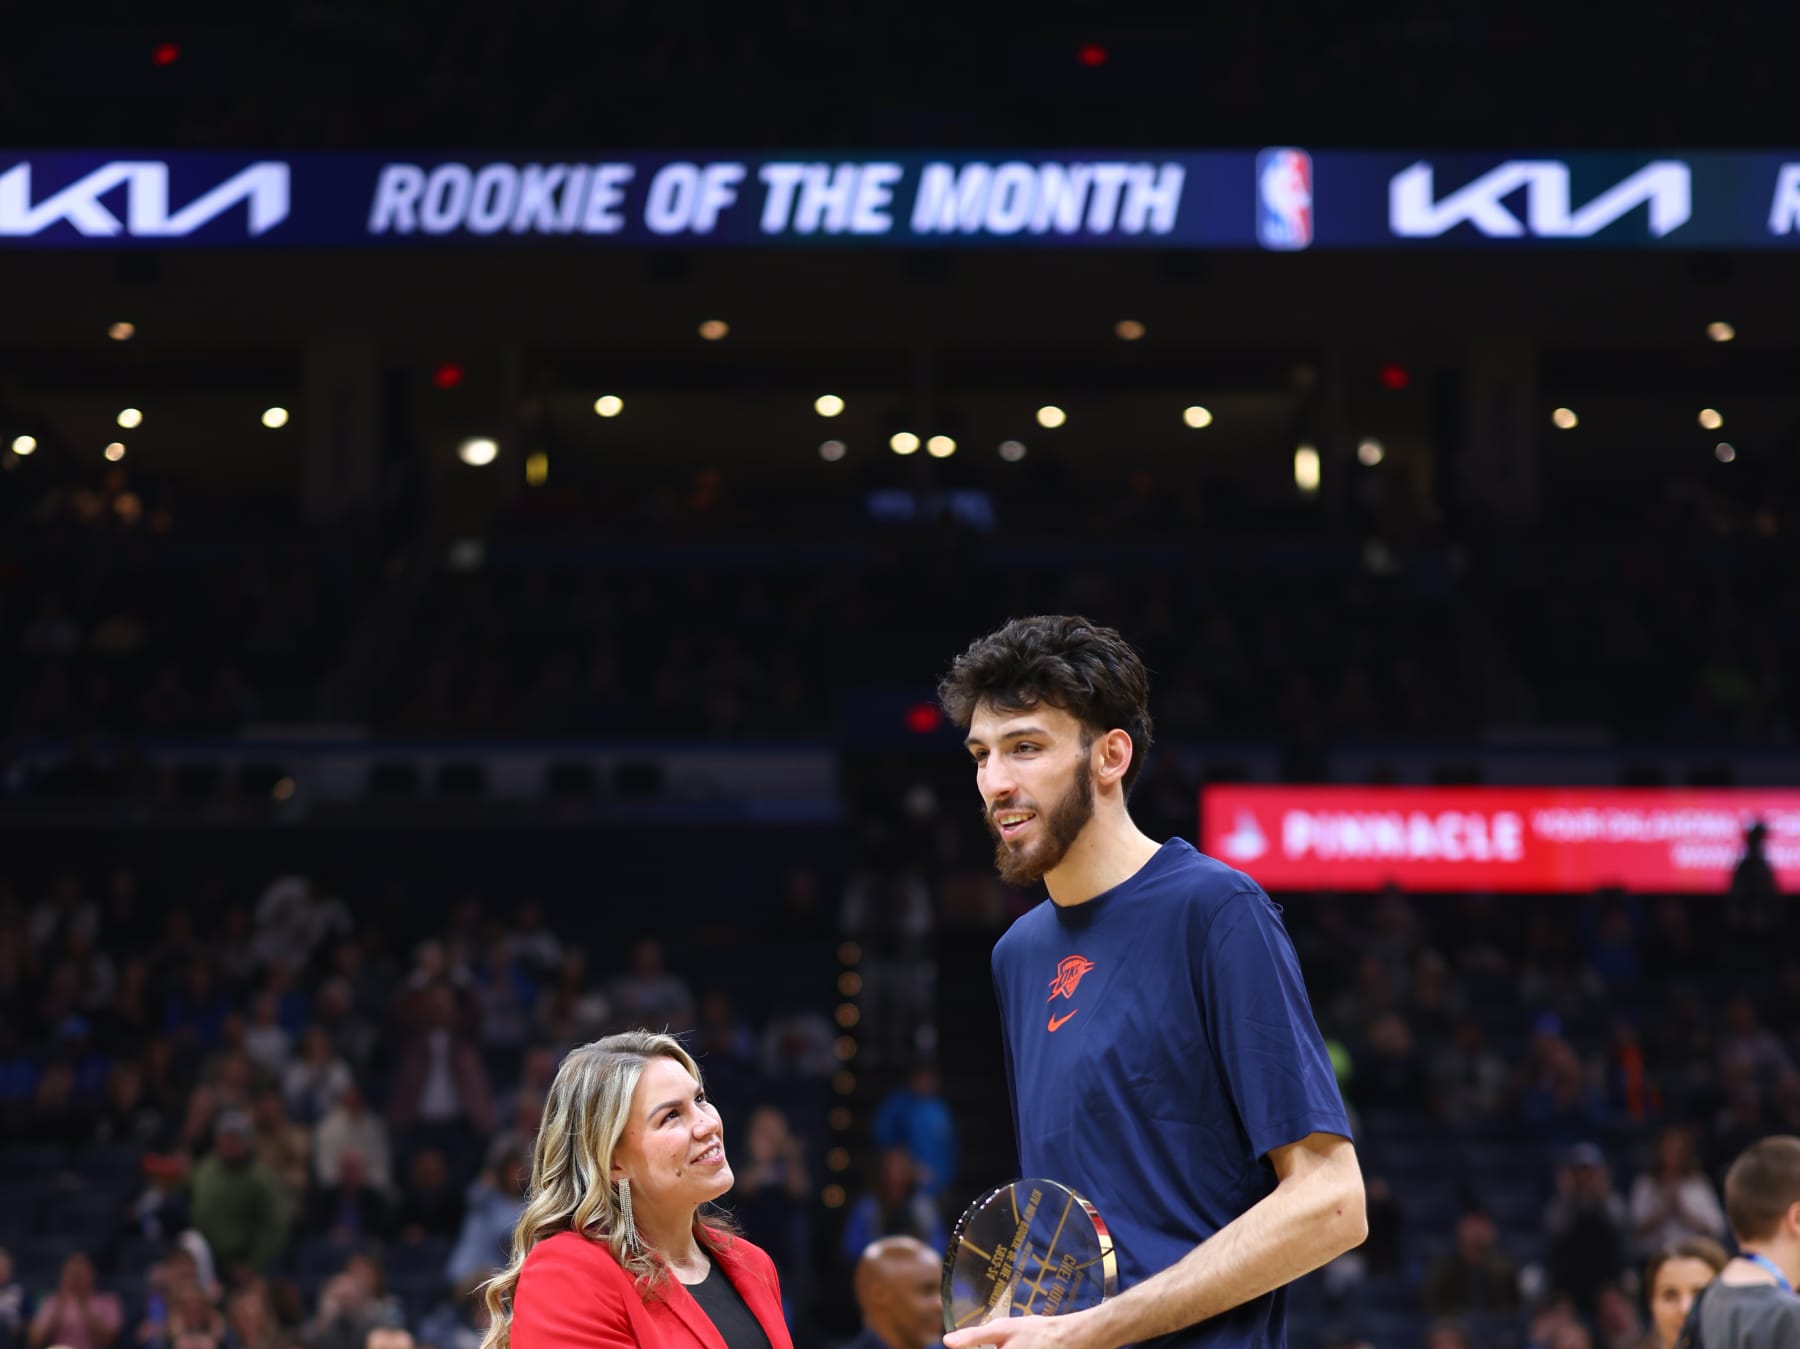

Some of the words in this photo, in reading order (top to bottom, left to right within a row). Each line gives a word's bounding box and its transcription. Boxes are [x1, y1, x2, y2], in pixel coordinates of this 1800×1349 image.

[368, 162, 635, 235] ROOKIE
[644, 162, 747, 235] OF
[758, 162, 905, 235] THE
[909, 161, 1187, 236] MONTH
[1282, 808, 1525, 862] PINNACLE
